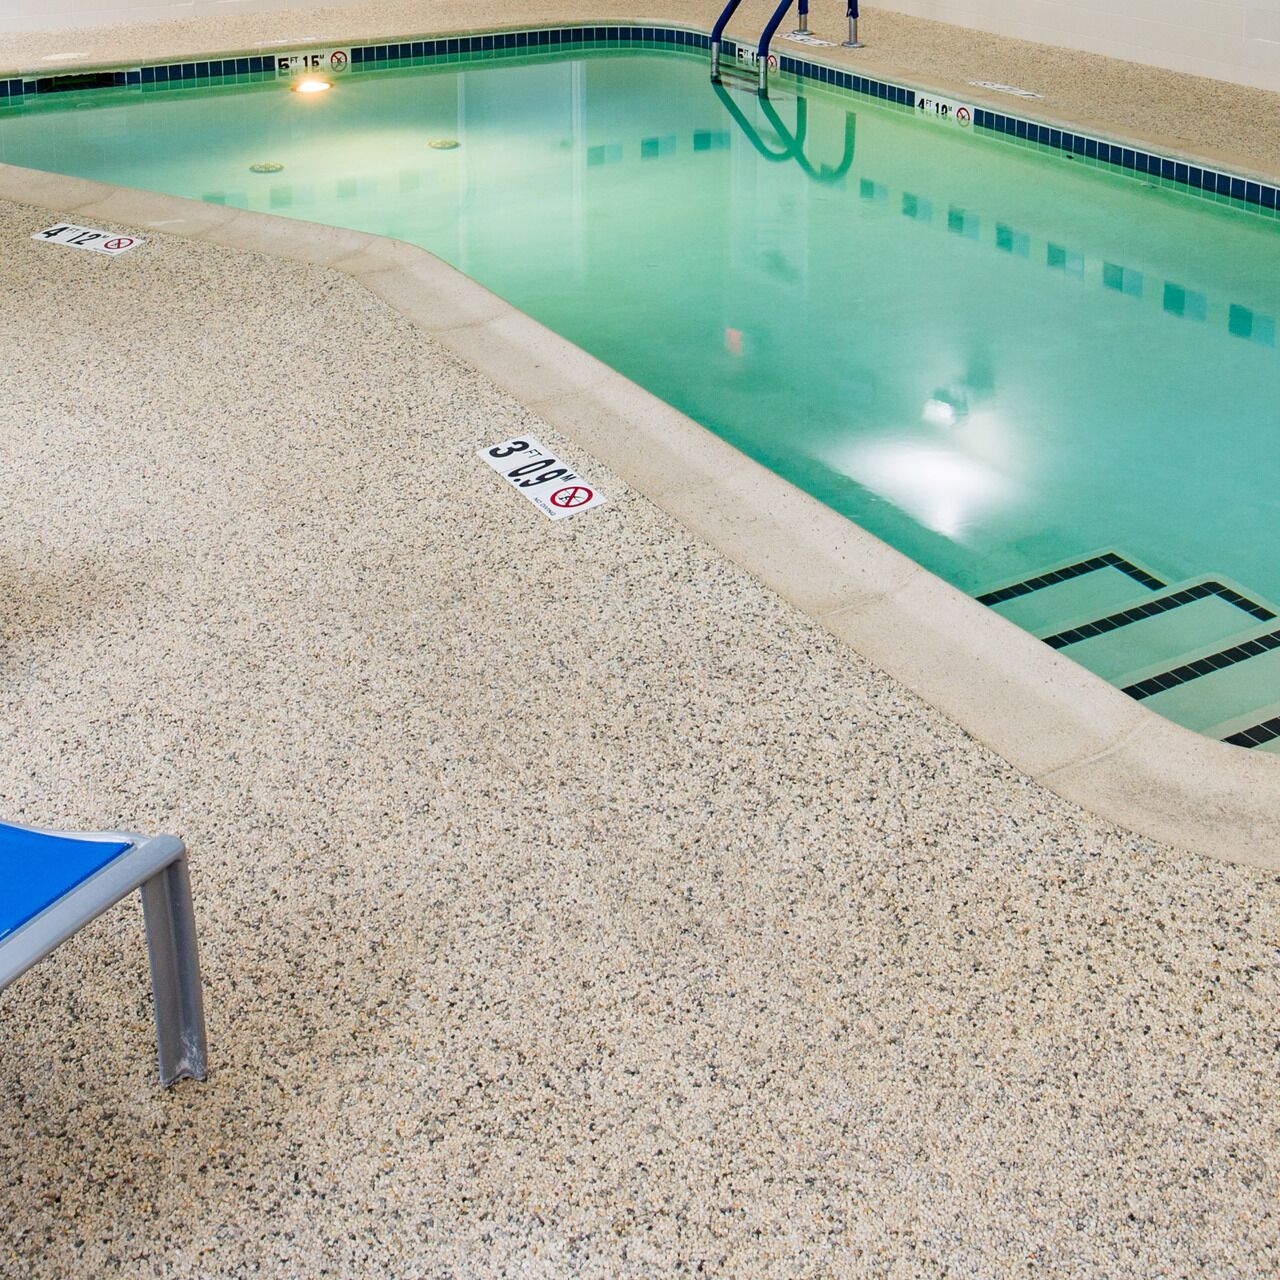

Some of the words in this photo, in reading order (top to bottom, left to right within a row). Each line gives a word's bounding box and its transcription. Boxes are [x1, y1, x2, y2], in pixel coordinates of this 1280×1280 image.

[277, 57, 290, 70] 5
[41, 226, 70, 239] 4
[489, 441, 530, 458] 3
[523, 448, 543, 459] FT
[507, 459, 568, 488] 0.9
[559, 473, 577, 483] M
